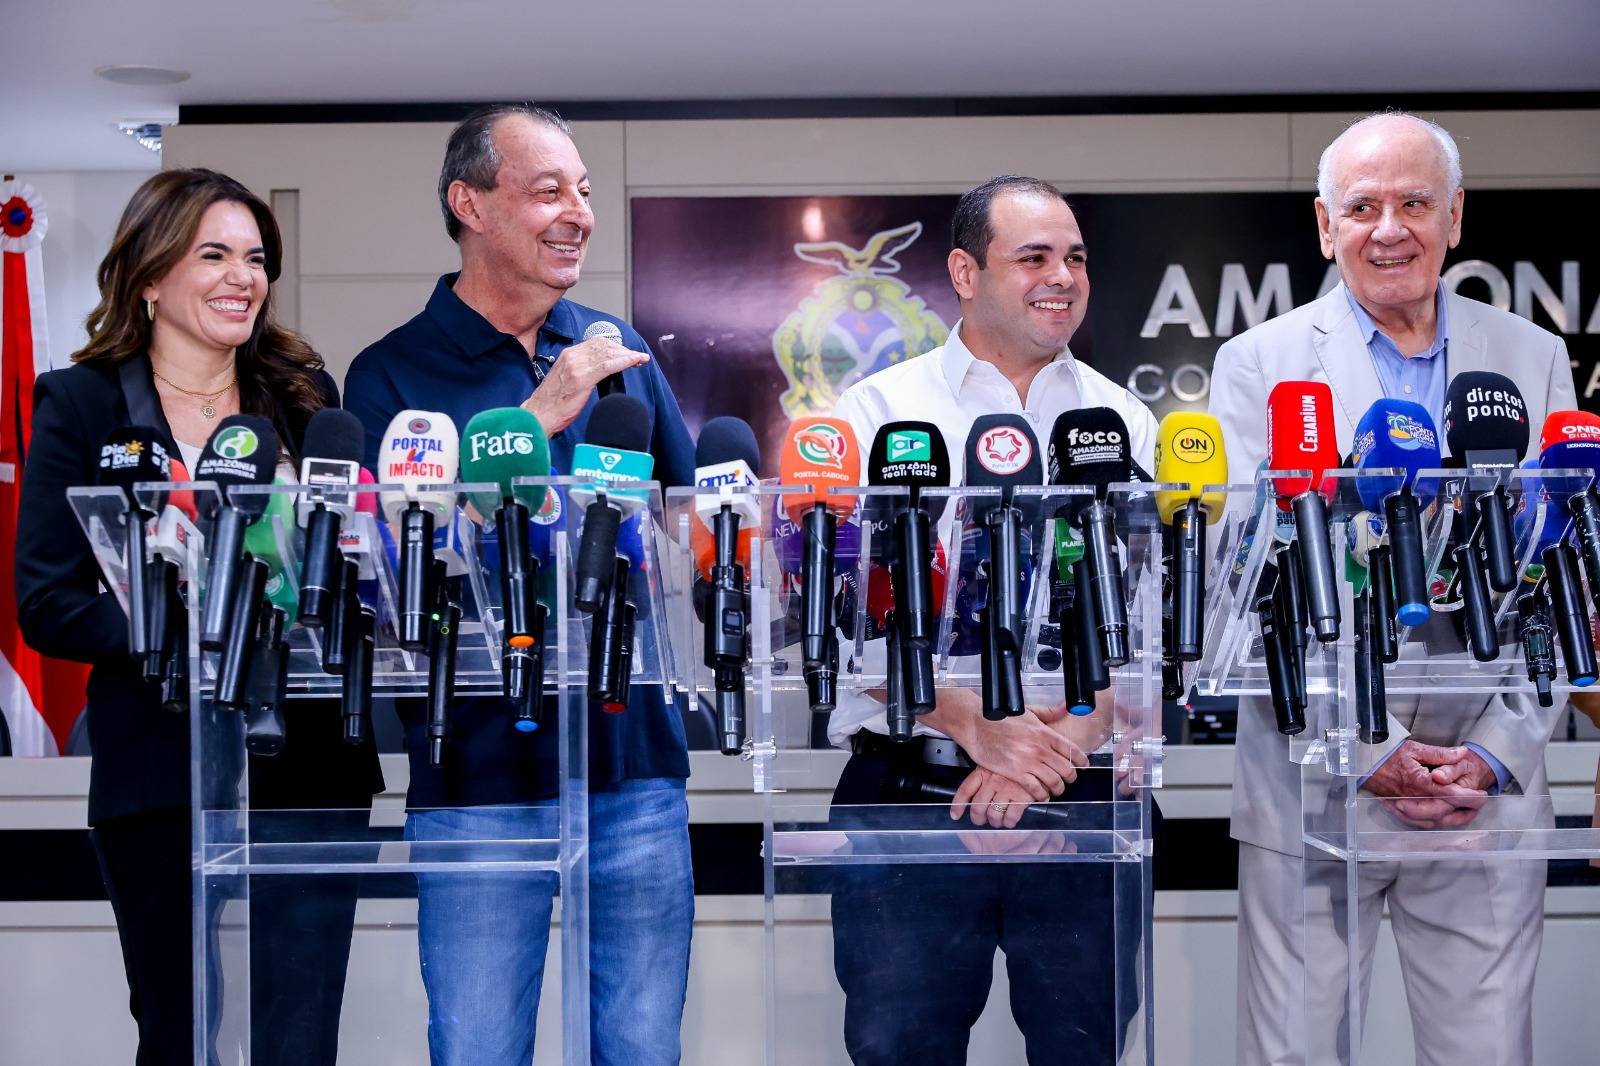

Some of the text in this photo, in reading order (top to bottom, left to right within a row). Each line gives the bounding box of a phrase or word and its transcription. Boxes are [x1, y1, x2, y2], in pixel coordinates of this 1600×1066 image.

[1466, 388, 1518, 406] direto
[1067, 428, 1122, 446] foco
[1409, 425, 1434, 438] PONTA
[1410, 431, 1435, 444] NEGRA
[101, 443, 126, 457] Dia
[392, 438, 443, 452] PORTAL
[469, 430, 534, 462] Fato
[1072, 445, 1121, 455] AMAZÔNICO
[1180, 437, 1207, 450] ON
[112, 453, 139, 465] Dia
[201, 458, 257, 474] AMAZÔNIA
[389, 463, 444, 478] IMPACTO
[793, 471, 820, 479] PORTAL
